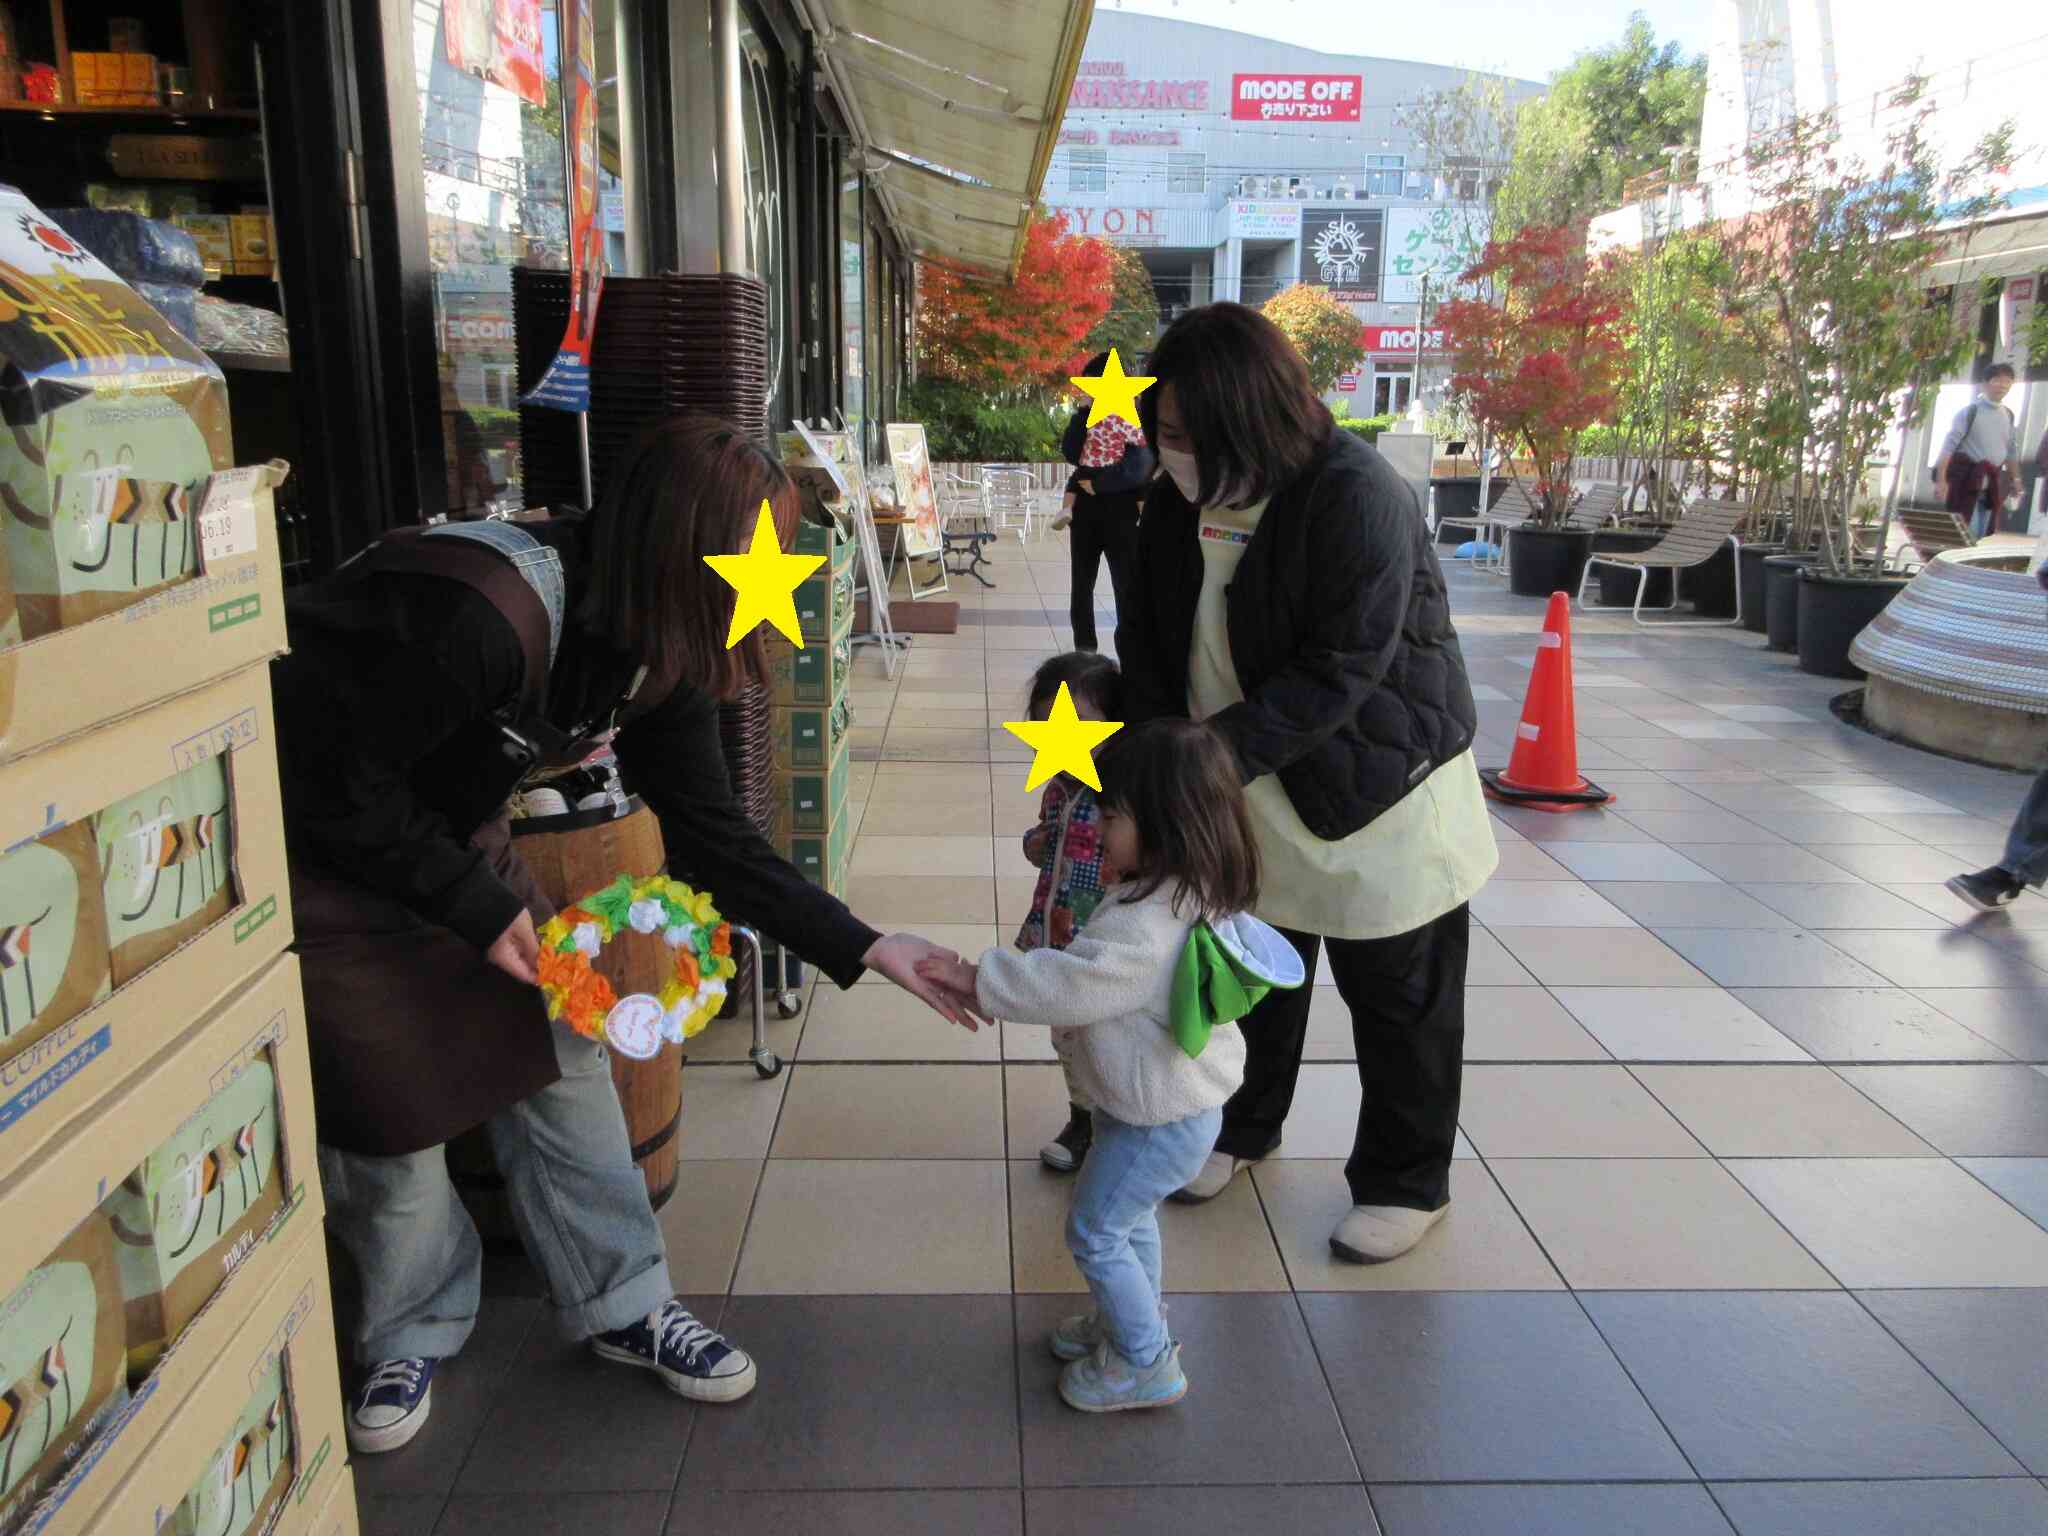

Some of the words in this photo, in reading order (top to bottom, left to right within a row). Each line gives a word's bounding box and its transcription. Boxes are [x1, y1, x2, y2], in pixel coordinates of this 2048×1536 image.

[1240, 80, 1306, 100] MODE
[1311, 81, 1354, 101] OFF
[1320, 264, 1360, 282] GYM
